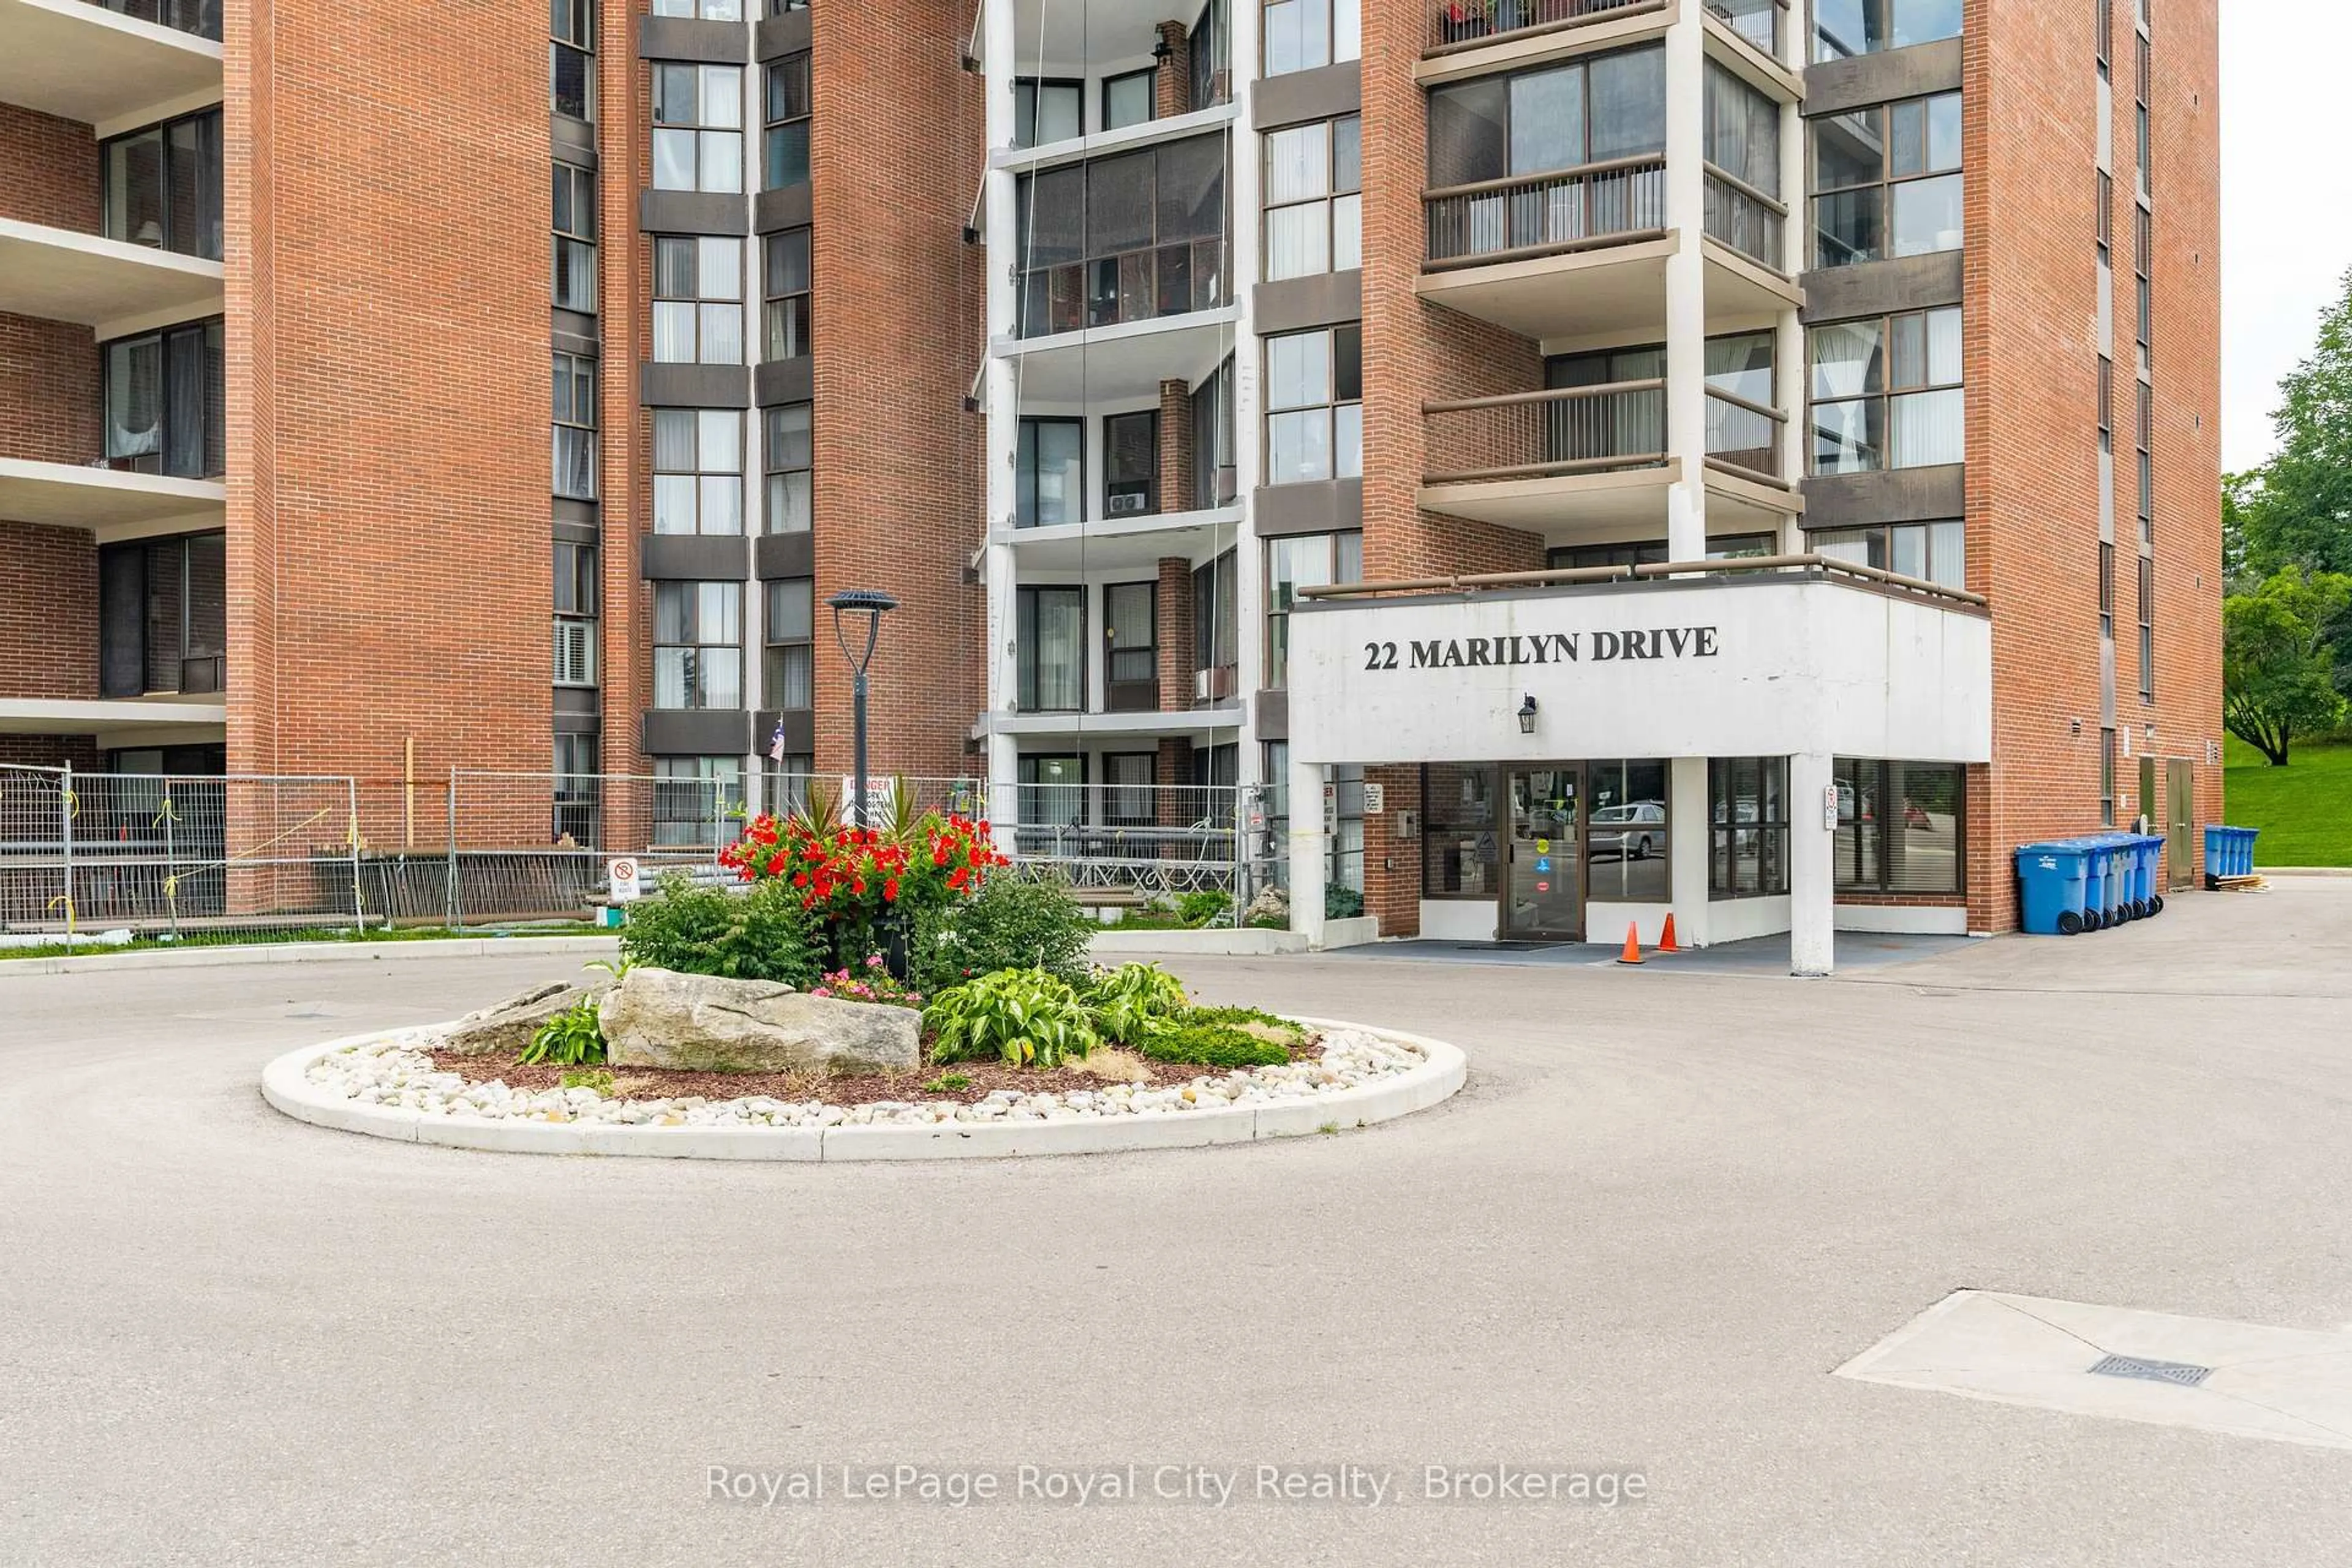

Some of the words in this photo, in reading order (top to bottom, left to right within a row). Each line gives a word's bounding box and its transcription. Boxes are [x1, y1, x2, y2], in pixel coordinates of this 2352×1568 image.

[1365, 642, 1398, 670] 22
[1409, 633, 1580, 668] MARILYN
[1592, 626, 1718, 661] DRIVE
